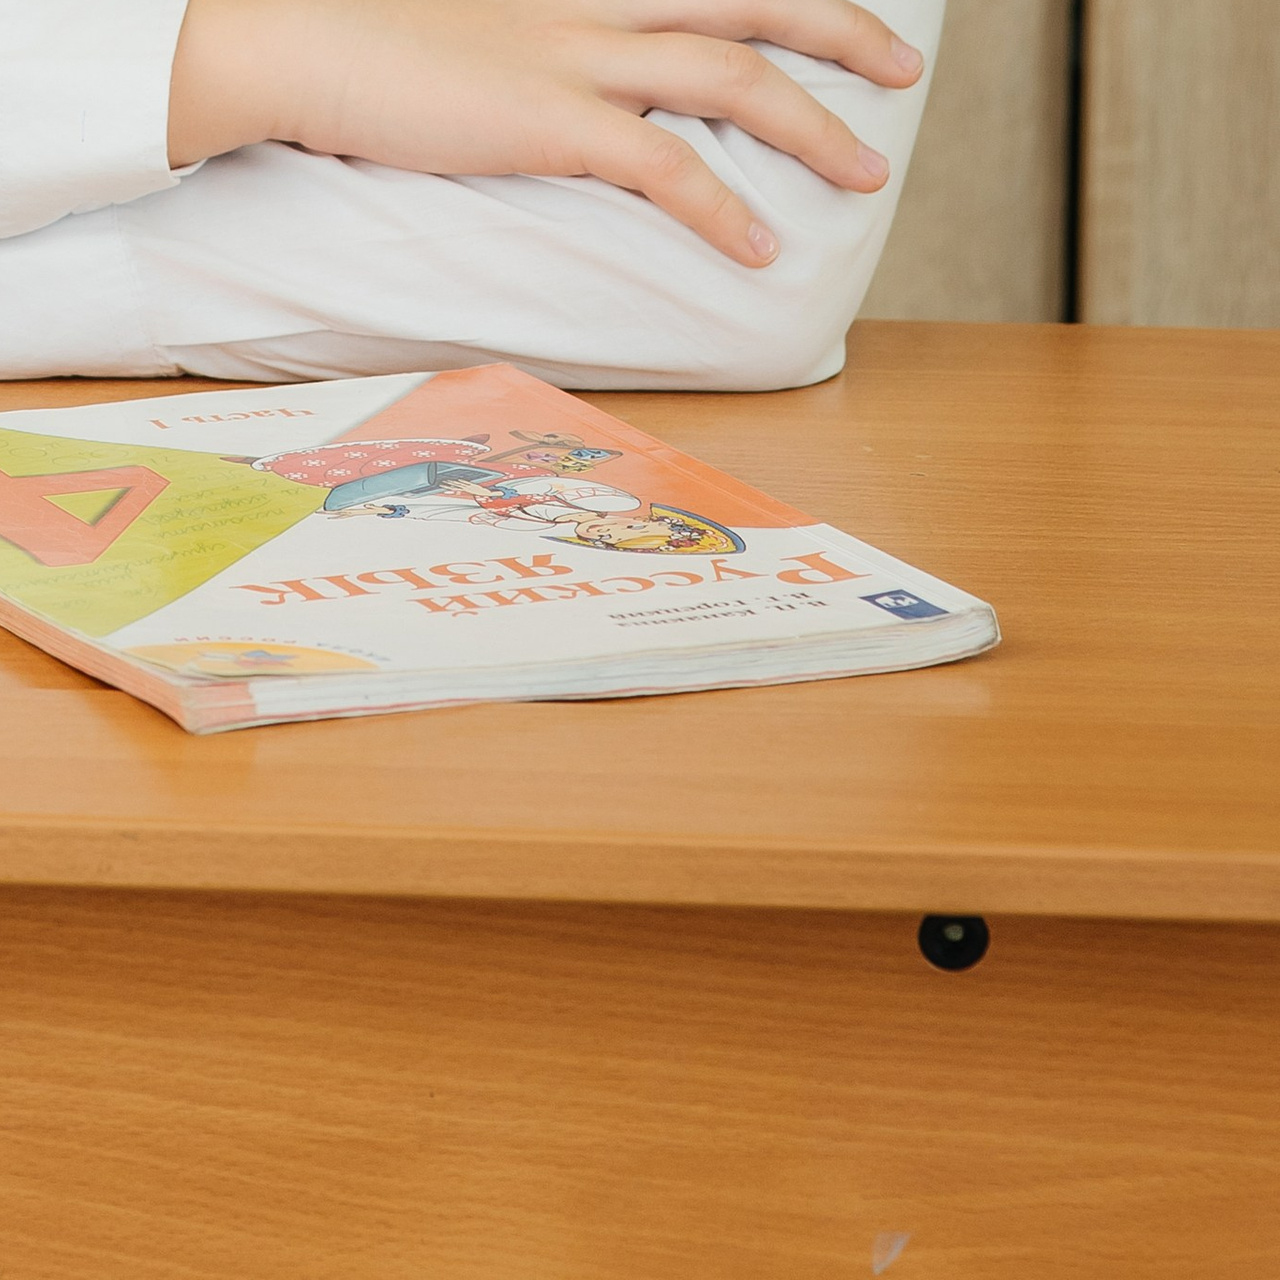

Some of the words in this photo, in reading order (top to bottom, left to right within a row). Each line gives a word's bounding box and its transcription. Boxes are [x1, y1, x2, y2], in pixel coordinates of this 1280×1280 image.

[148, 419, 173, 431] 1
[180, 408, 315, 425] Часть
[407, 549, 874, 618] Русский
